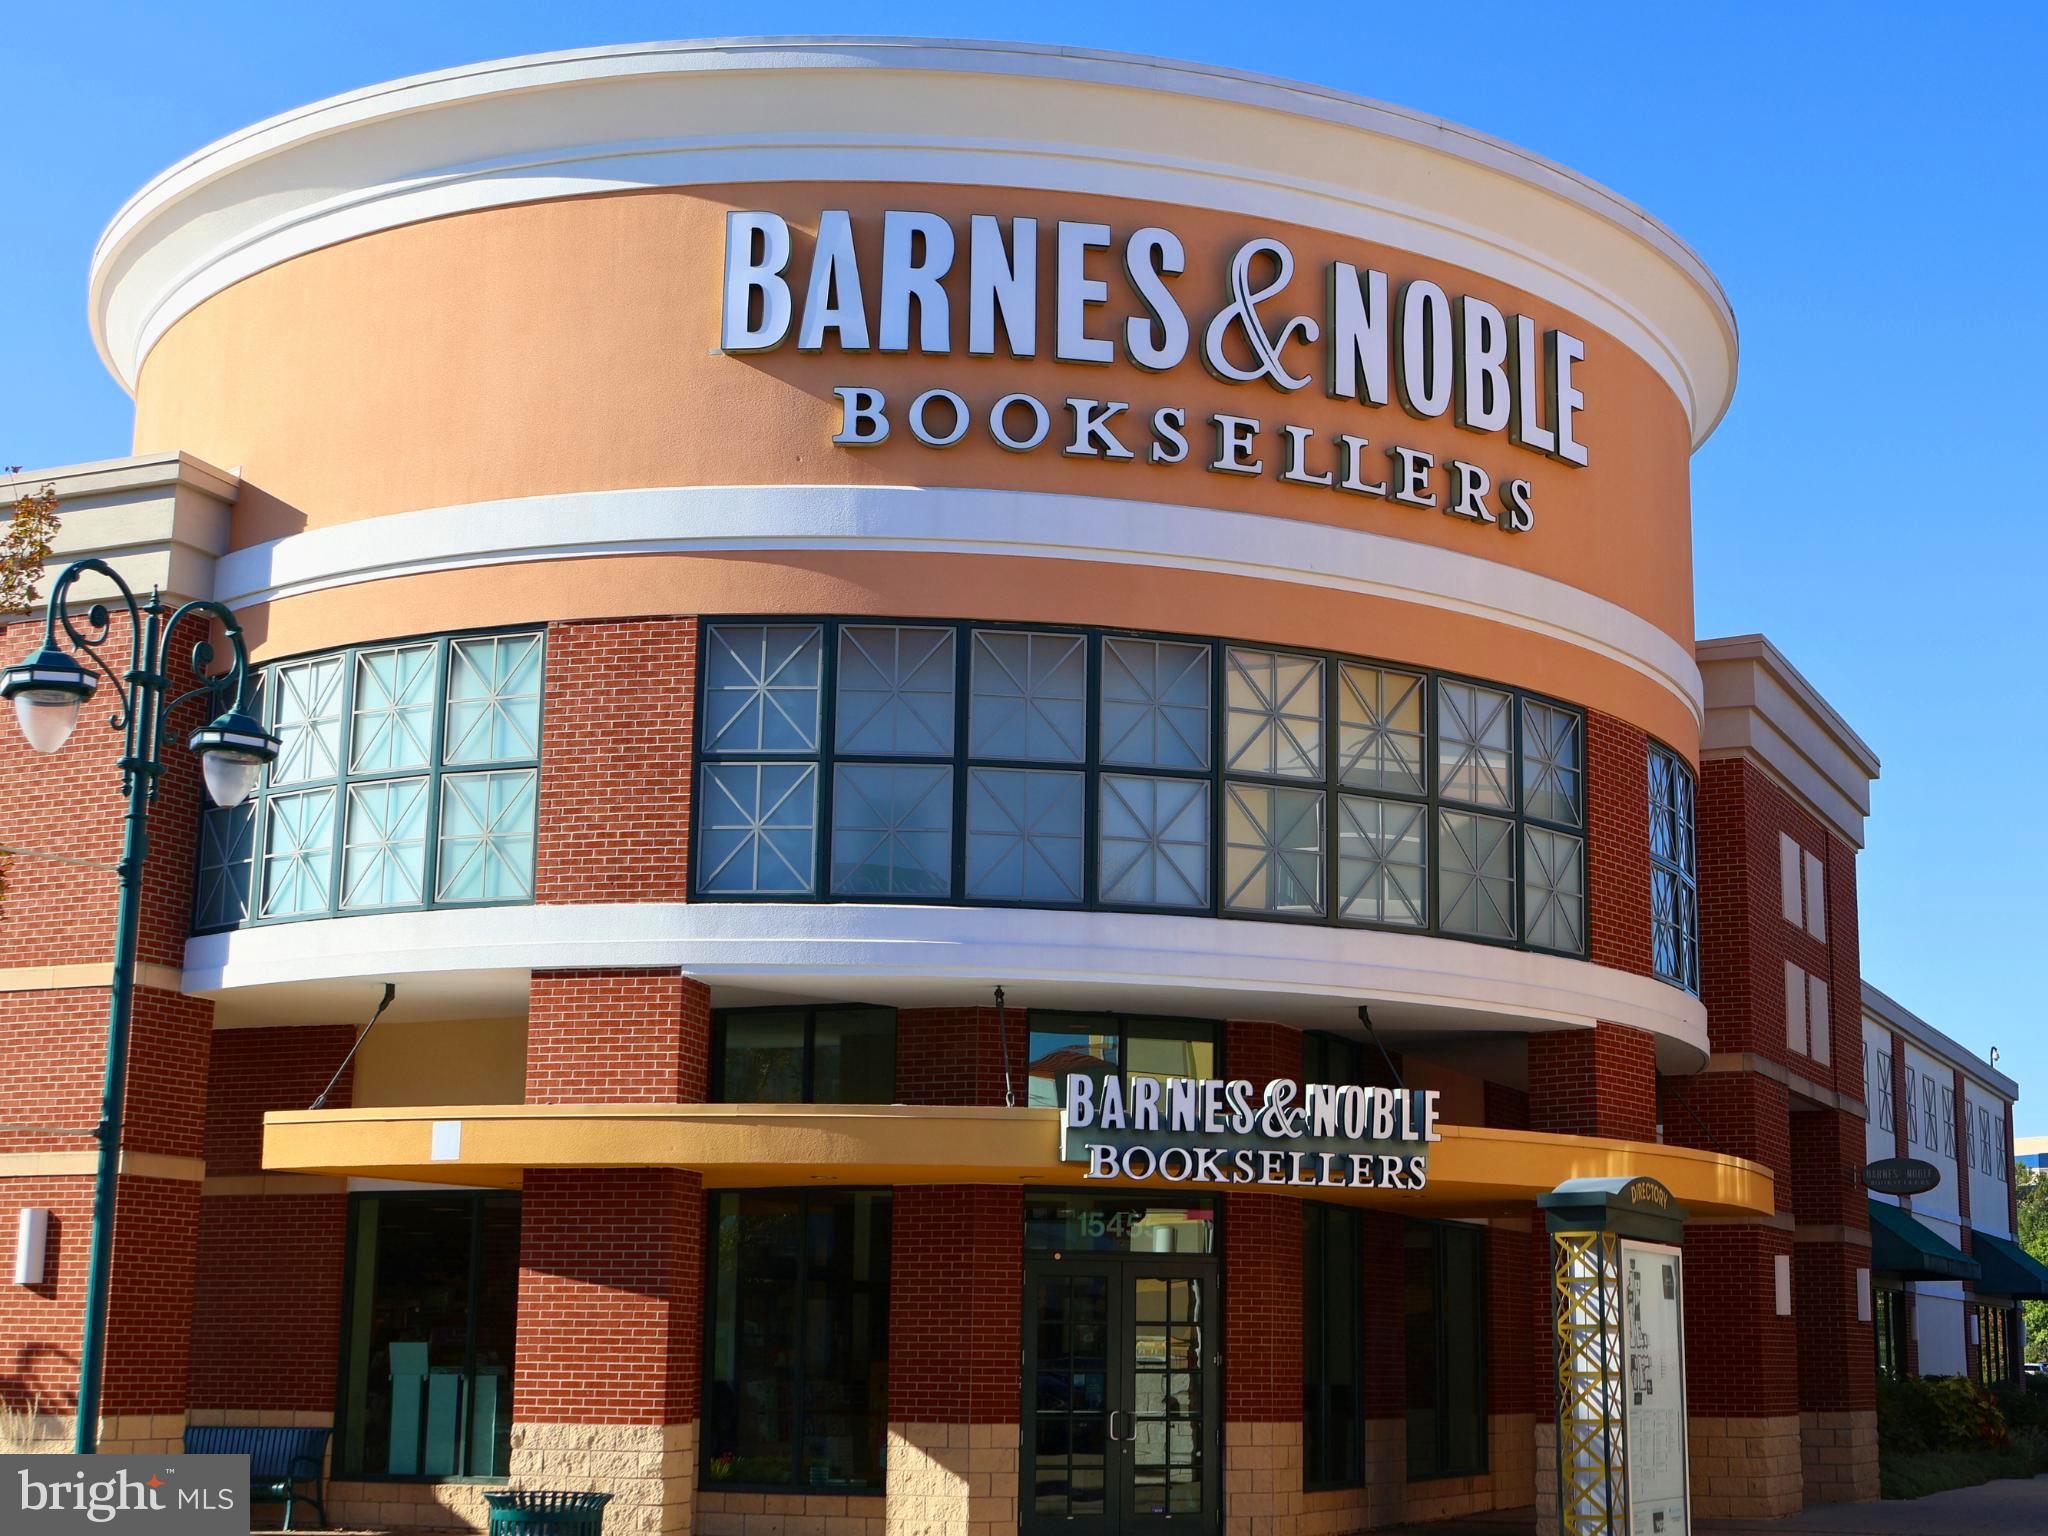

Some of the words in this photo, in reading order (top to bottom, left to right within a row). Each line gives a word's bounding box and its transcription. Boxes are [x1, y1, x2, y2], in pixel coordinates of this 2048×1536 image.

[720, 210, 1190, 374] BARNES
[1326, 260, 1589, 468] NOBLE
[832, 386, 1535, 534] BOOKSELLERS
[1066, 1073, 1254, 1135] BARNES
[1305, 1083, 1442, 1142] NOBLE
[1084, 1143, 1427, 1190] BOOKSELLERS
[1631, 1182, 1668, 1210] DIRECTORY
